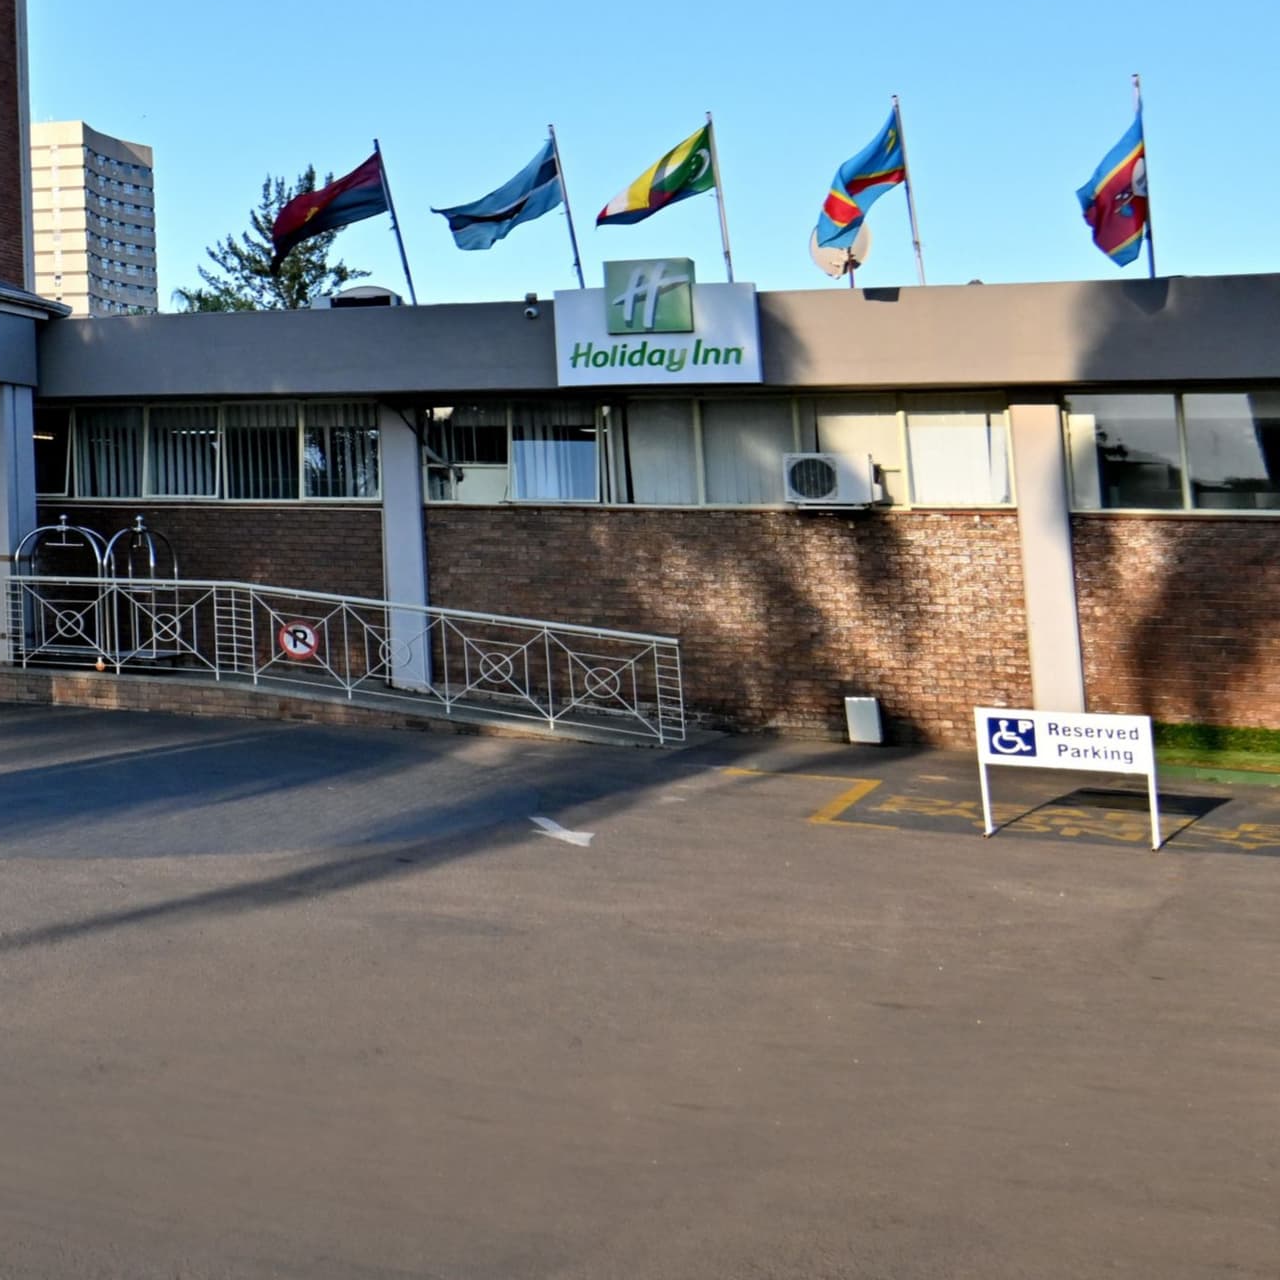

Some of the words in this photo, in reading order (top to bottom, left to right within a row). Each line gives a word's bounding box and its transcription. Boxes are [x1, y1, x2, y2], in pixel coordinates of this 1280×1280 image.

[569, 340, 688, 373] Holiday
[692, 339, 744, 366] Inn
[1018, 719, 1034, 734] P
[1047, 722, 1140, 741] Reserved
[1057, 743, 1134, 764] Parking
